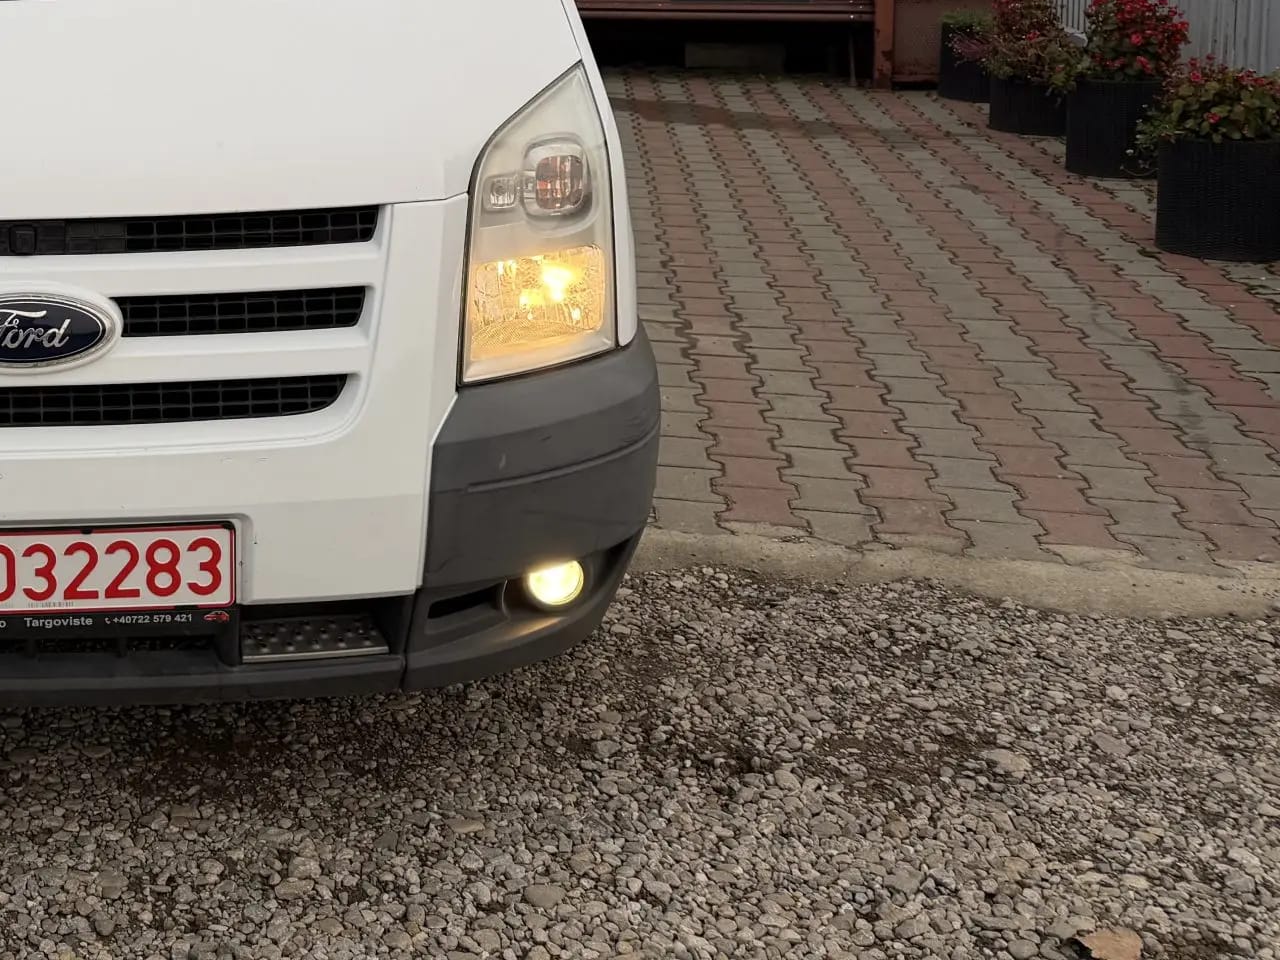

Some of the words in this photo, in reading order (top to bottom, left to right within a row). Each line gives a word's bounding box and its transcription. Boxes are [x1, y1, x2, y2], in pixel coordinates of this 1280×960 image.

[23, 615, 93, 630] Targoviste
[153, 613, 173, 624] 579
[175, 613, 193, 623] 421
